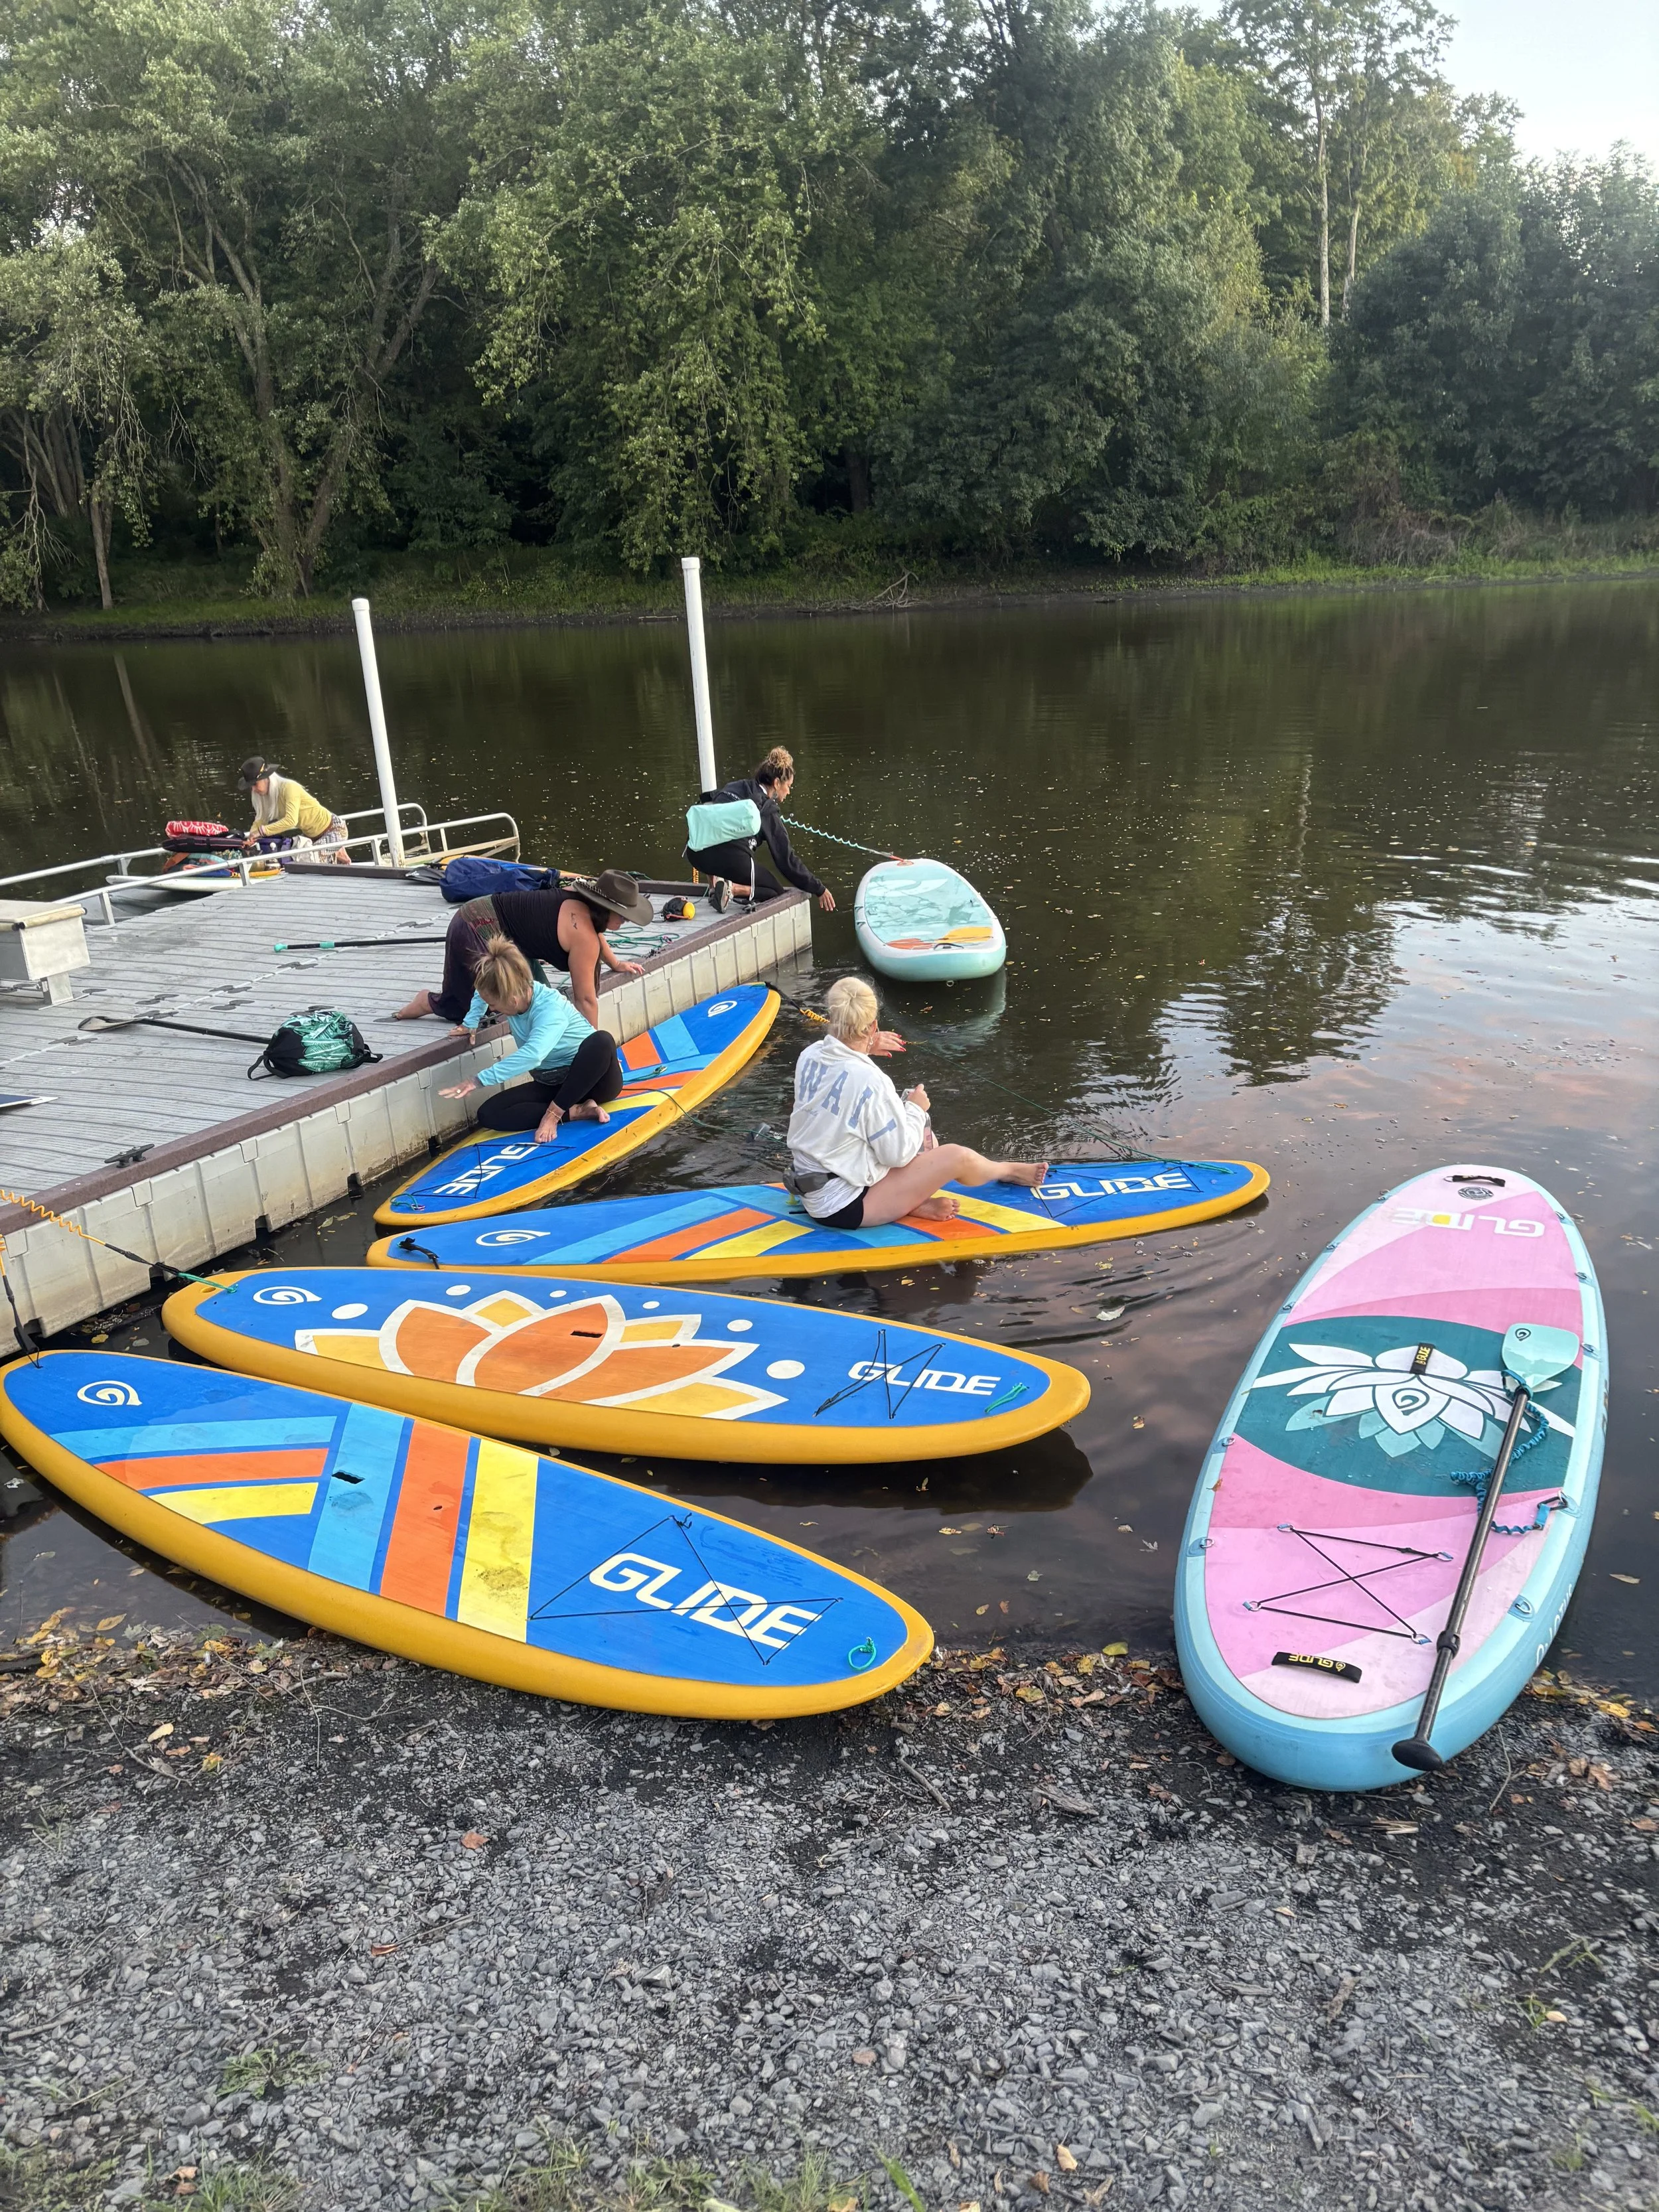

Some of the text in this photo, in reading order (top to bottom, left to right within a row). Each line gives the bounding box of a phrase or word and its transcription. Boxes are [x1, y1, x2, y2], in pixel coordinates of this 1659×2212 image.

[433, 1142, 540, 1195] GLIDE
[1031, 1173, 1192, 1200] GLIDE
[1391, 1207, 1546, 1238] GLIDE
[847, 1361, 1001, 1396] GLIDE
[589, 1552, 822, 1650] GLIDE
[1288, 1653, 1334, 1668] GLIDE
